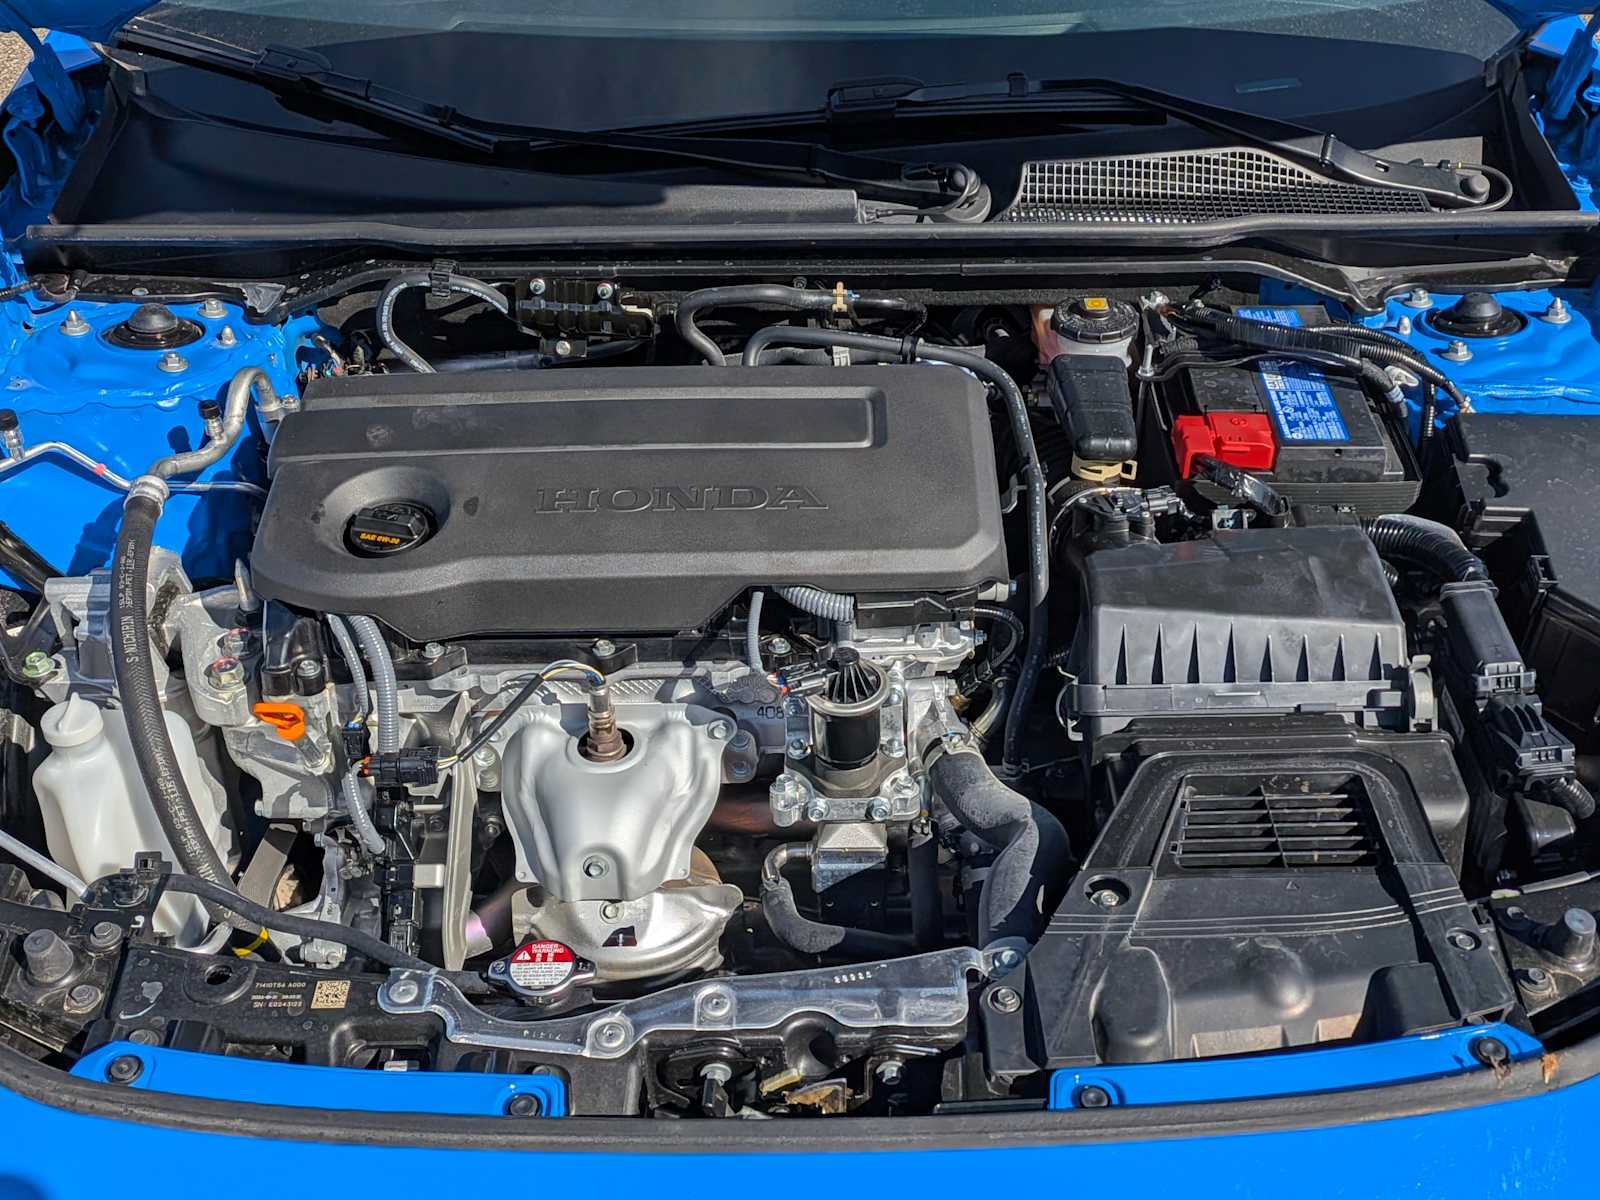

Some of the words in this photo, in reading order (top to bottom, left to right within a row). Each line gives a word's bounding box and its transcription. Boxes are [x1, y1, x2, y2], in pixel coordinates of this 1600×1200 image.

[535, 485, 829, 513] HONDA
[360, 532, 377, 541] SAE
[377, 535, 400, 545] 0W-20
[120, 615, 137, 654] NICHIRIN
